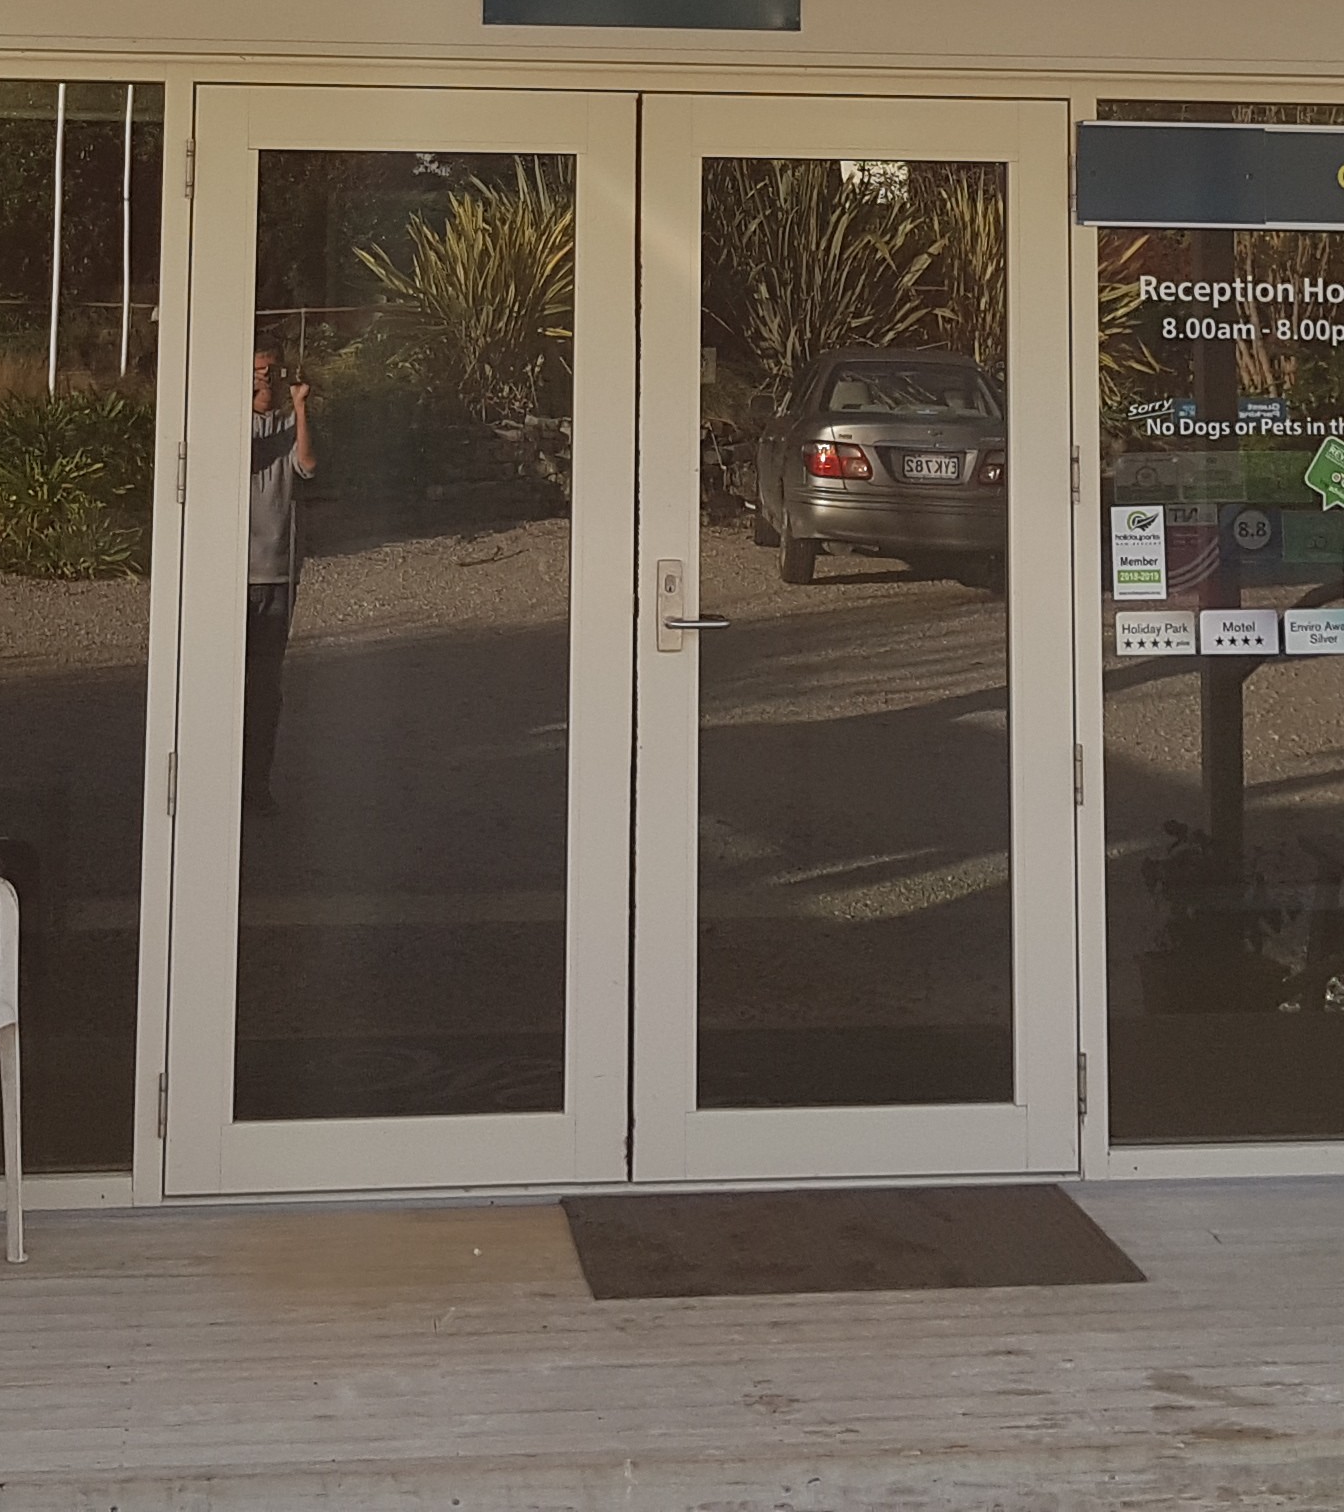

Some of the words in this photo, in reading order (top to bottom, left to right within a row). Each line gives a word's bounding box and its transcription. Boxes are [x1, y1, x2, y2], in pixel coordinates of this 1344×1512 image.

[1138, 274, 1295, 306] Reception
[1162, 317, 1255, 341] 8.00am
[1147, 418, 1175, 435] No
[1179, 418, 1230, 439] Dogs
[1235, 422, 1256, 435] or
[1261, 418, 1302, 435] Pets
[1307, 418, 1325, 435] in
[1238, 522, 1267, 538] 8.8
[1120, 556, 1158, 566] Member
[1122, 623, 1162, 636] Holiday
[1164, 623, 1189, 633] Park
[1222, 621, 1256, 632] Motel
[1290, 621, 1322, 632] Enviro
[1309, 633, 1338, 644] Silver
